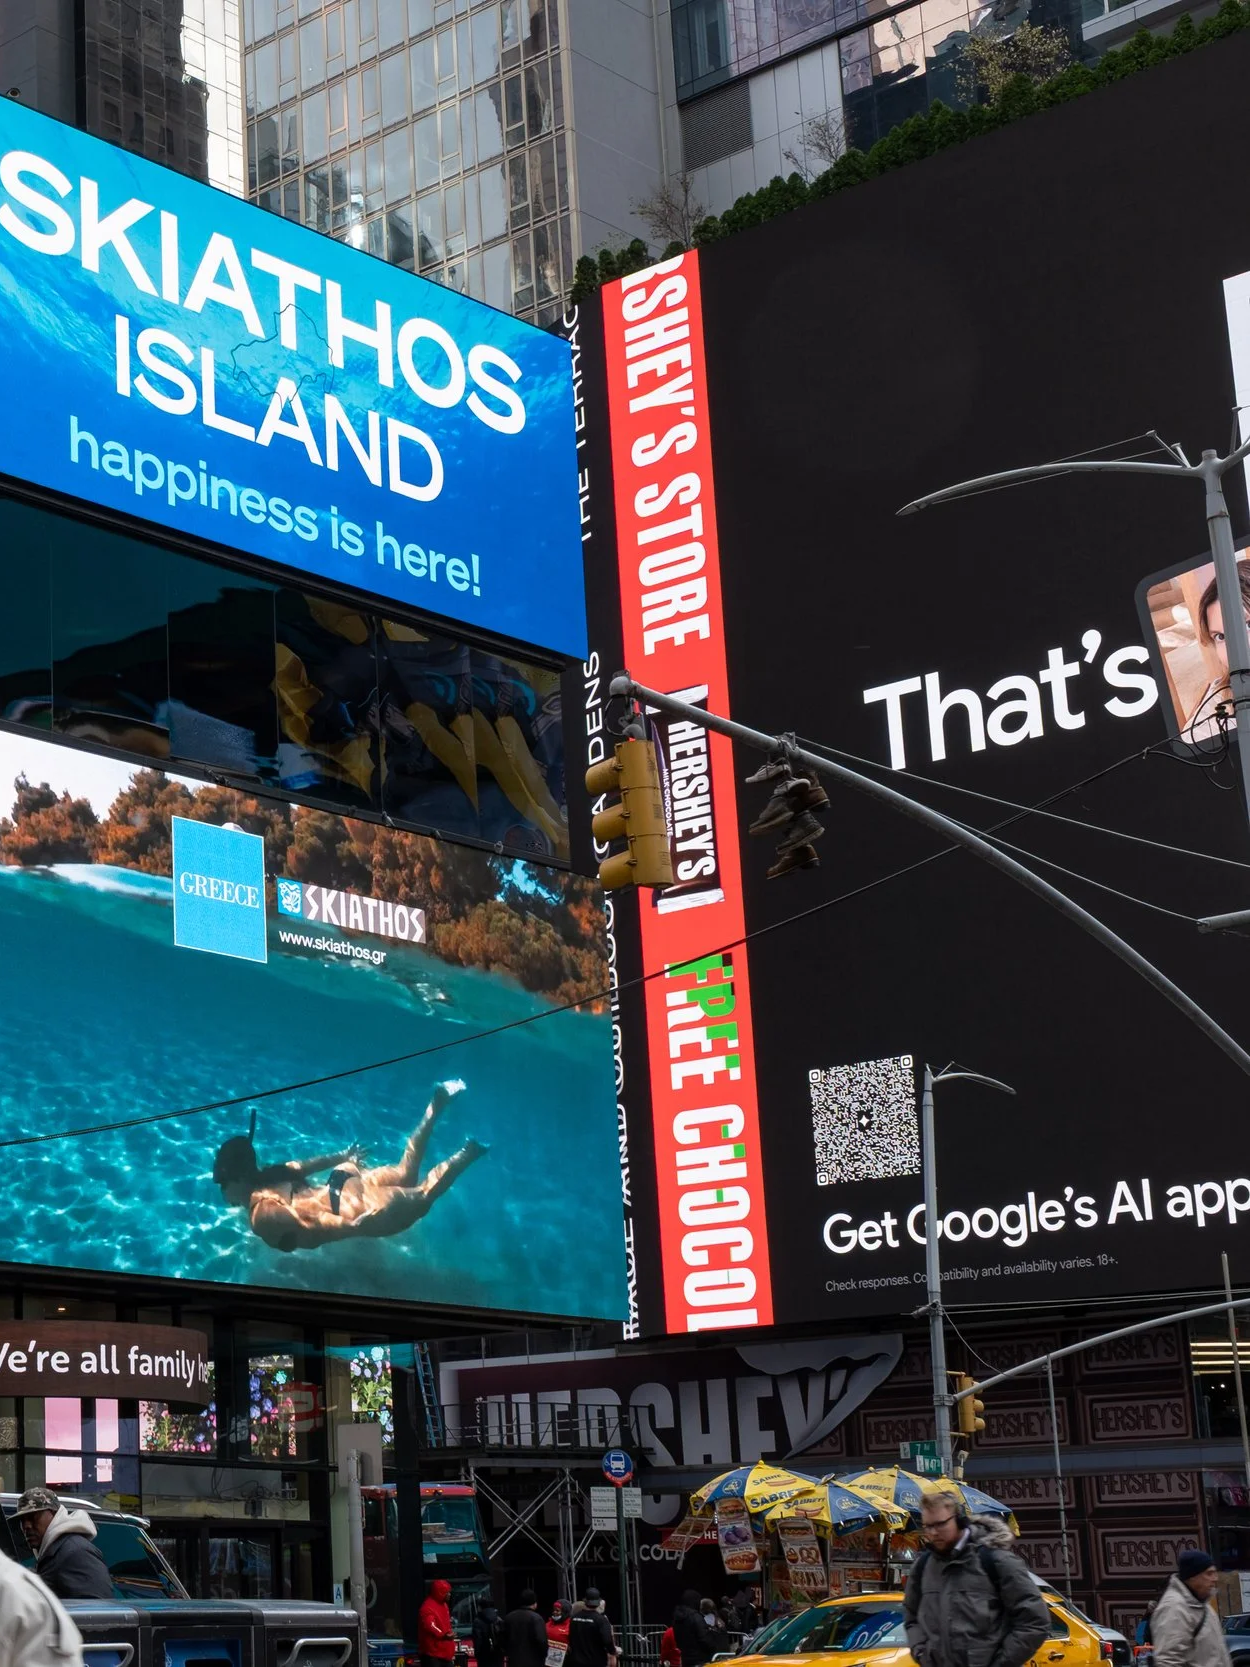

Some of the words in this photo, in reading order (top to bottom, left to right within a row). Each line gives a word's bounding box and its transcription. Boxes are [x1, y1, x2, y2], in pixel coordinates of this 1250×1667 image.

[114, 314, 445, 503] ISLAND
[69, 415, 319, 543] happiness
[331, 506, 365, 558] is
[376, 520, 482, 597] here!
[634, 471, 712, 657] STORE
[862, 628, 1160, 771] That's
[666, 720, 717, 881] HERSHEY'S
[179, 871, 261, 909] GREECE
[304, 884, 426, 943] SKIATHOS
[279, 929, 387, 965] www.skiathos.gr
[664, 953, 741, 1090] FREE
[672, 1104, 758, 1332] CHOCOL
[823, 1211, 900, 1254] Get
[906, 1186, 1098, 1248] Google's
[1108, 1178, 1153, 1225] AI
[1166, 1178, 1250, 1228] app
[825, 1279, 857, 1293] Check
[858, 1274, 911, 1290] responses.
[913, 1267, 979, 1284] Coatibility
[981, 1264, 1001, 1277] and
[1003, 1259, 1058, 1275] availability
[1059, 1256, 1095, 1270] varies.
[1096, 1253, 1119, 1266] 18+.
[81, 1344, 119, 1375] all
[129, 1346, 195, 1388] family
[1093, 1400, 1184, 1437] HERSHEY'S
[750, 1488, 804, 1508] SABRE
[335, 1590, 342, 1599] A
